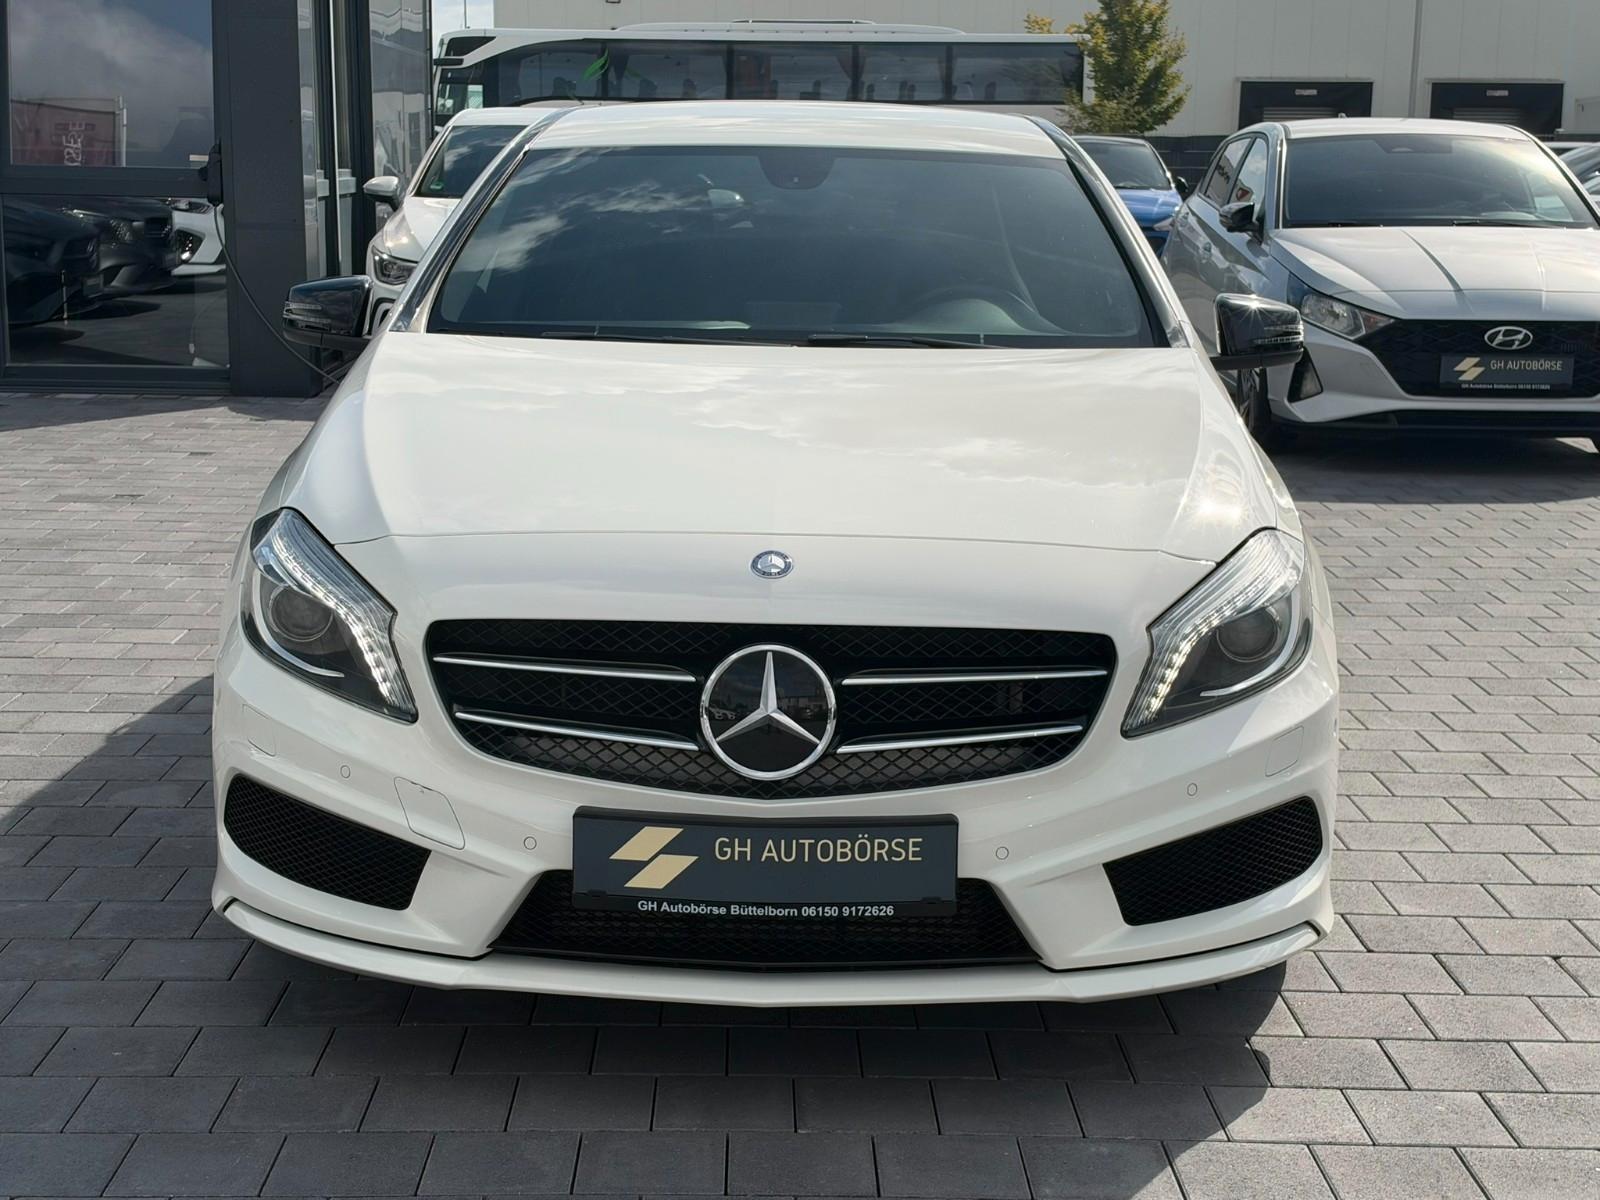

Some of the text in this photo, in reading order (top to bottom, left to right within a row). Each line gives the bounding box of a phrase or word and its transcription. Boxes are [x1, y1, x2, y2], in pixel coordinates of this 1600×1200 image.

[1490, 358, 1563, 371] GH AUTOBÖRSE
[714, 833, 923, 863] GH AUTOBÖRSE
[637, 900, 894, 917] GH Autobörse Büttelborn 06150 9172626
